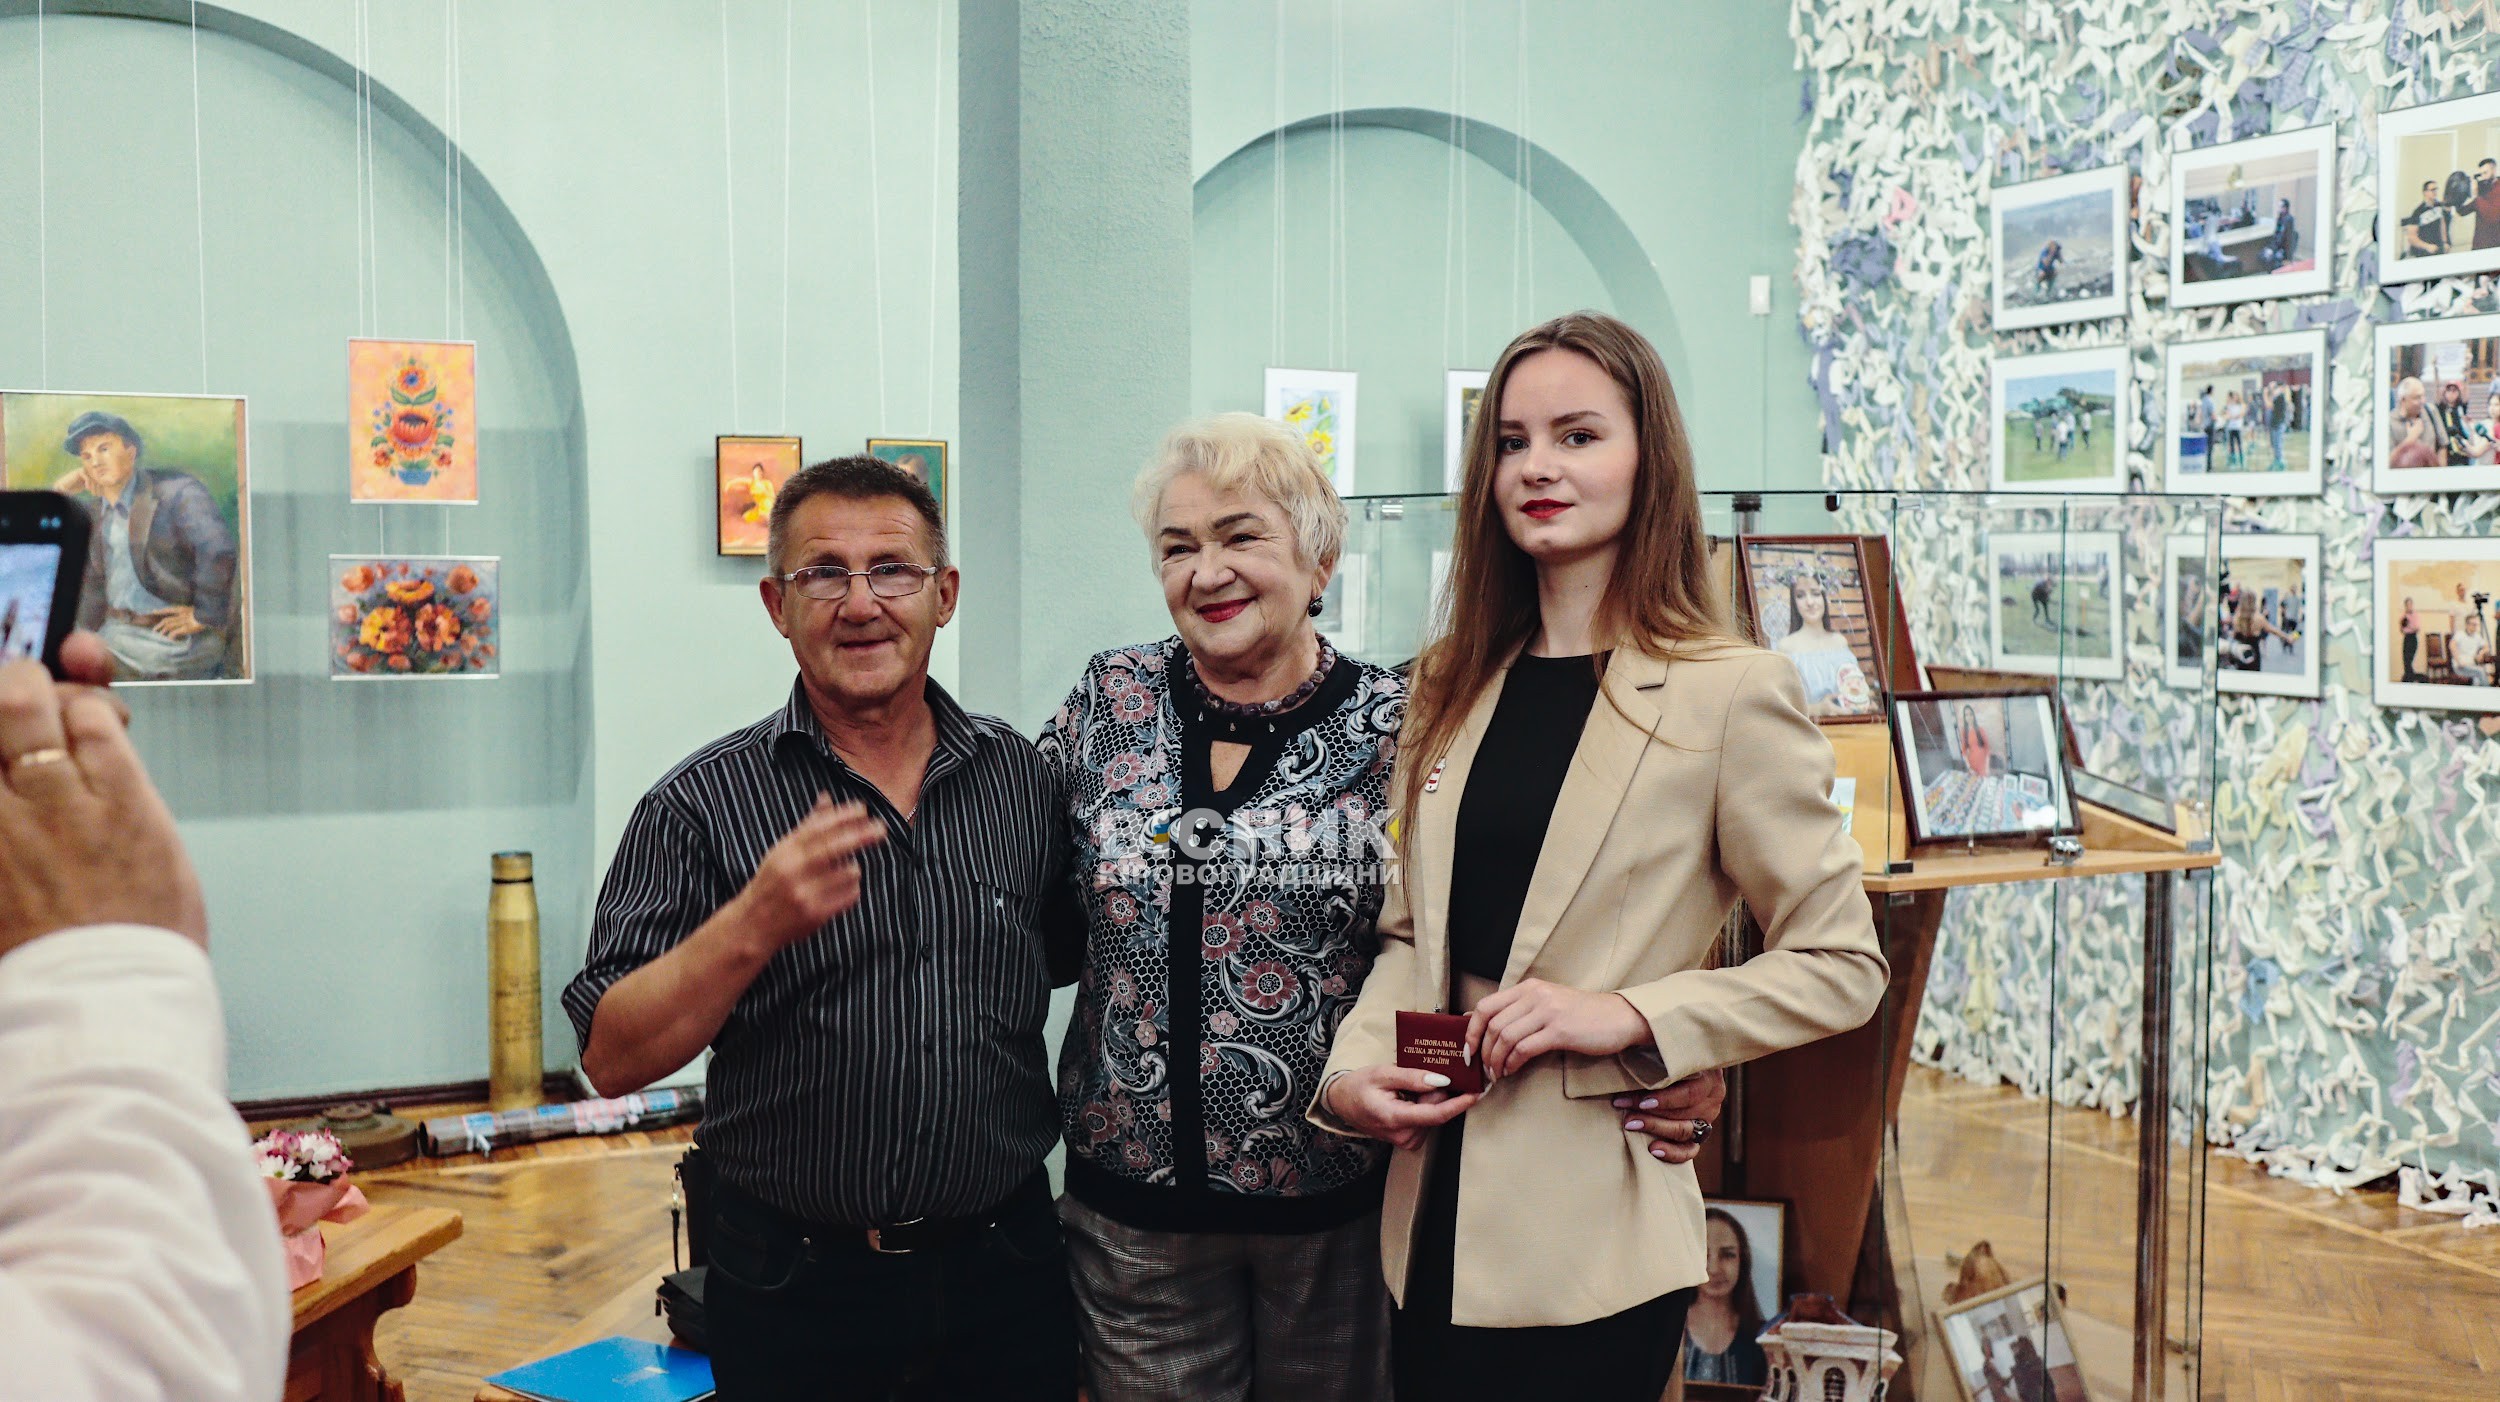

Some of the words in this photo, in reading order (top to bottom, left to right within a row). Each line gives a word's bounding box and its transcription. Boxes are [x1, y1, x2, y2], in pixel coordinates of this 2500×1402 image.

[1414, 1039, 1457, 1048] НАЦІОНАЛЬНА
[1404, 1046, 1426, 1054] СПІЛКА
[1423, 1056, 1450, 1065] УКРАЇНИ
